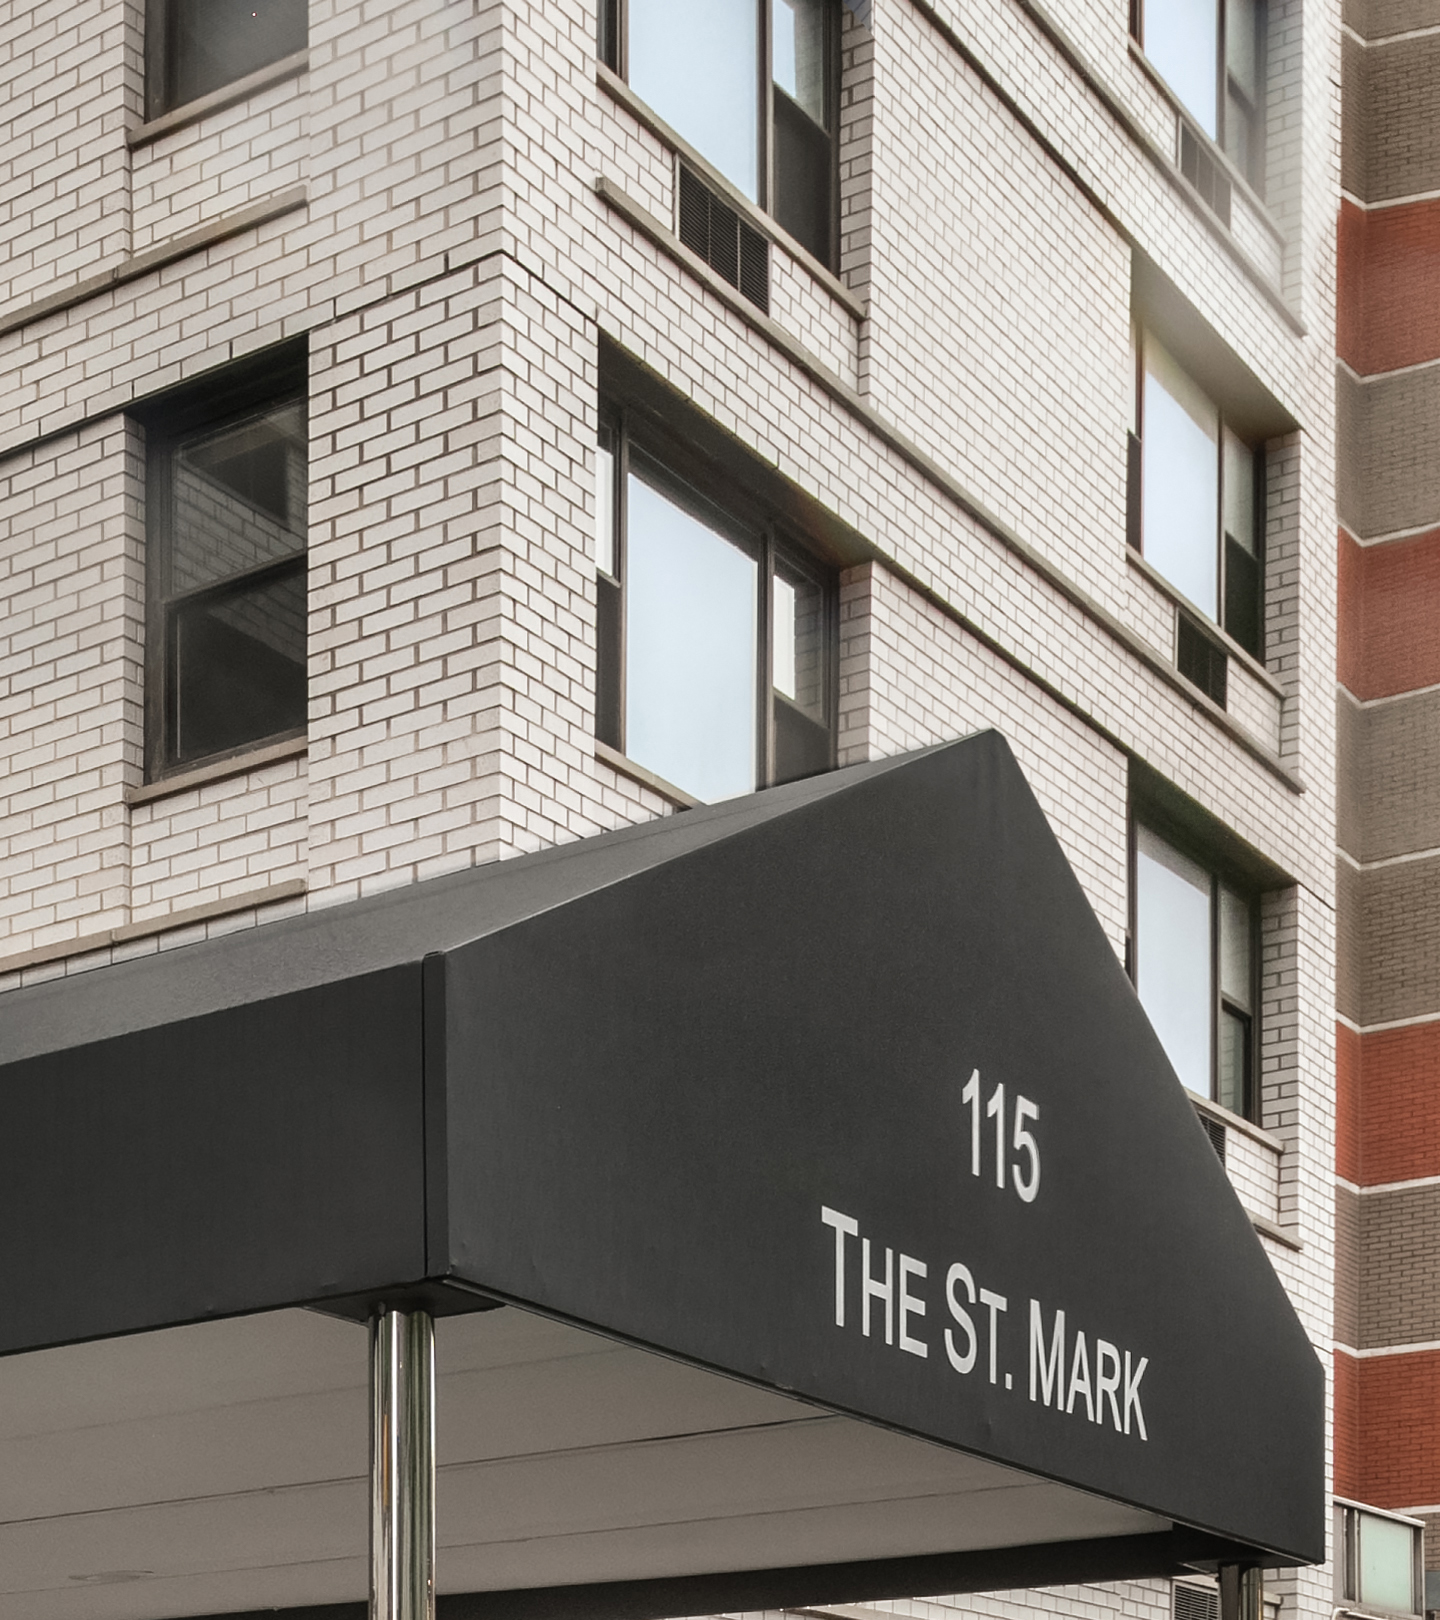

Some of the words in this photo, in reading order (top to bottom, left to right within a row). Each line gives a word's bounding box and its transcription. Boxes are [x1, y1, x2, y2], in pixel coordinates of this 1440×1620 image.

[962, 1068, 1041, 1203] 115
[821, 1205, 928, 1359] THE
[944, 1262, 1013, 1390] ST.
[1029, 1298, 1149, 1442] MARK
